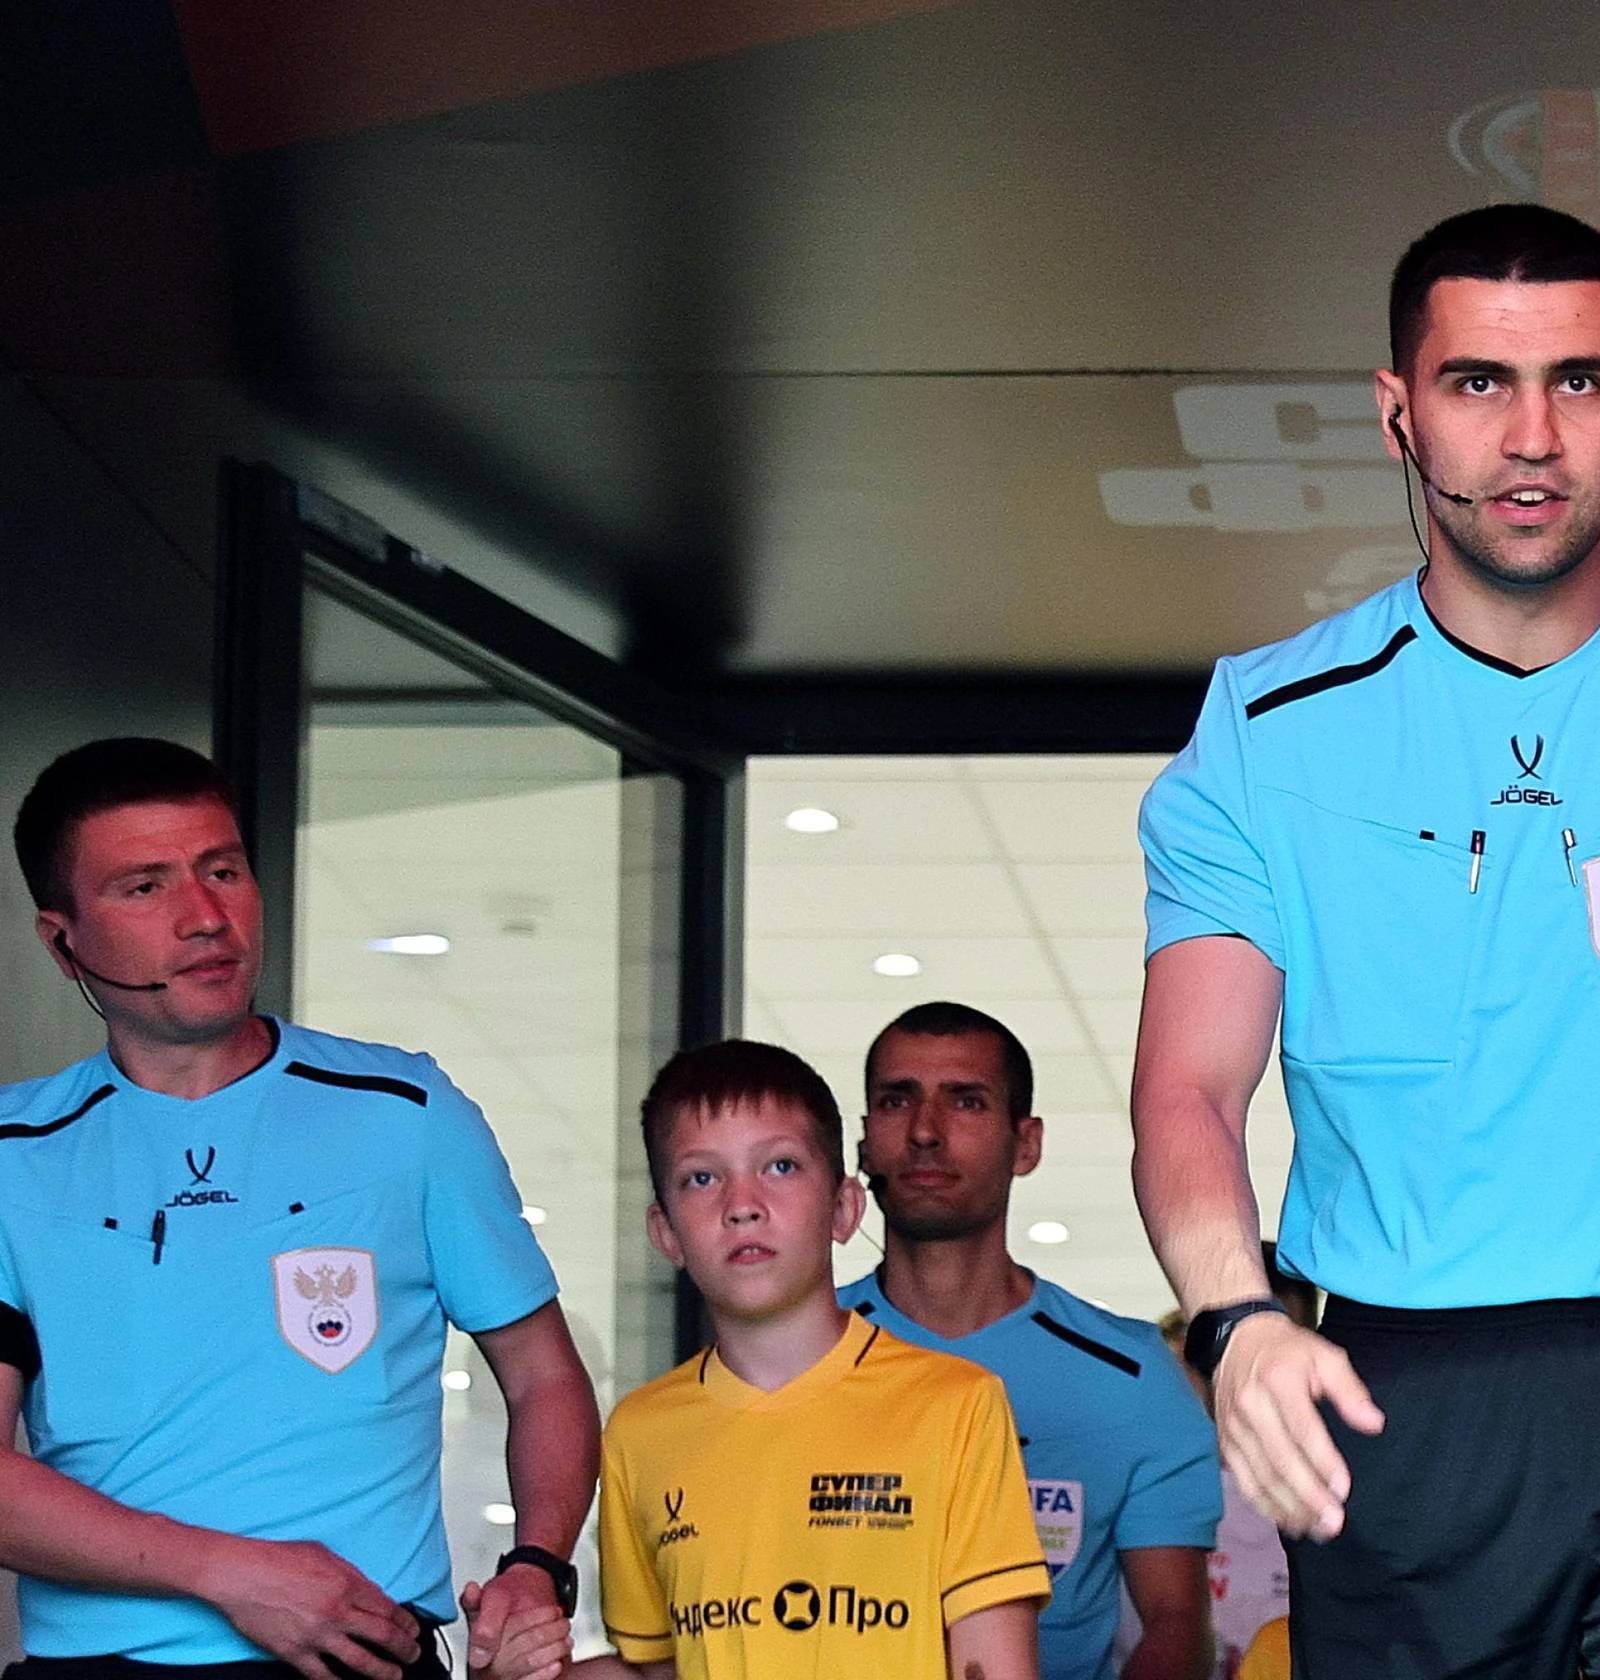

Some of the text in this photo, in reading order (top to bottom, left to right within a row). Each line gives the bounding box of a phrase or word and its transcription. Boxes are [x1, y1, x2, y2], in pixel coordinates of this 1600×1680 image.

[1490, 785, 1563, 806] JÖGEL
[165, 1190, 239, 1208] JÖGEL
[811, 1473, 902, 1491] СУПЕР
[809, 1494, 912, 1514] ФИНАЛ
[1028, 1487, 1073, 1513] FA
[670, 1585, 909, 1640] ндекс Про
